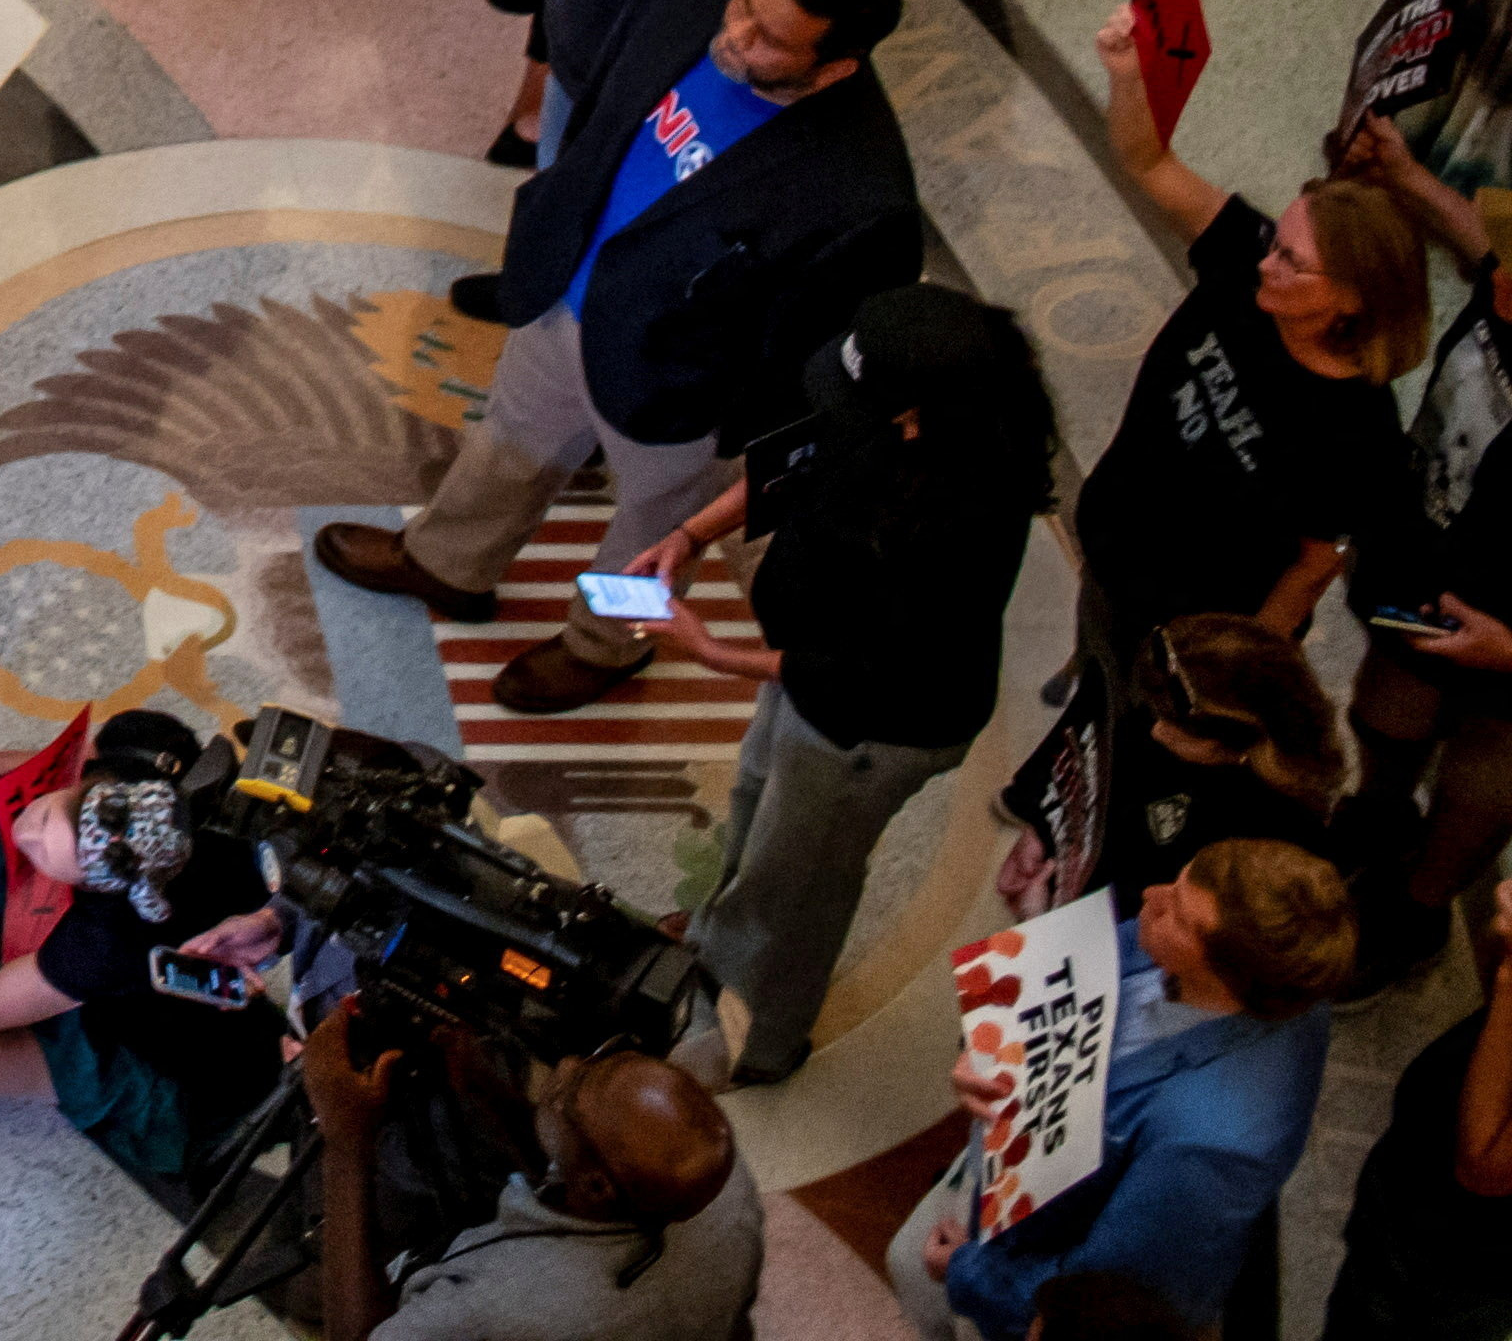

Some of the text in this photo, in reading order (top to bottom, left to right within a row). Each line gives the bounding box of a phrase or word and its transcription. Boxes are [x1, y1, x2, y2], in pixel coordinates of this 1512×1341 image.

[1017, 1009, 1046, 1138] FIRST
[1043, 957, 1074, 1157] TEXANS
[1080, 993, 1104, 1086] PUT
